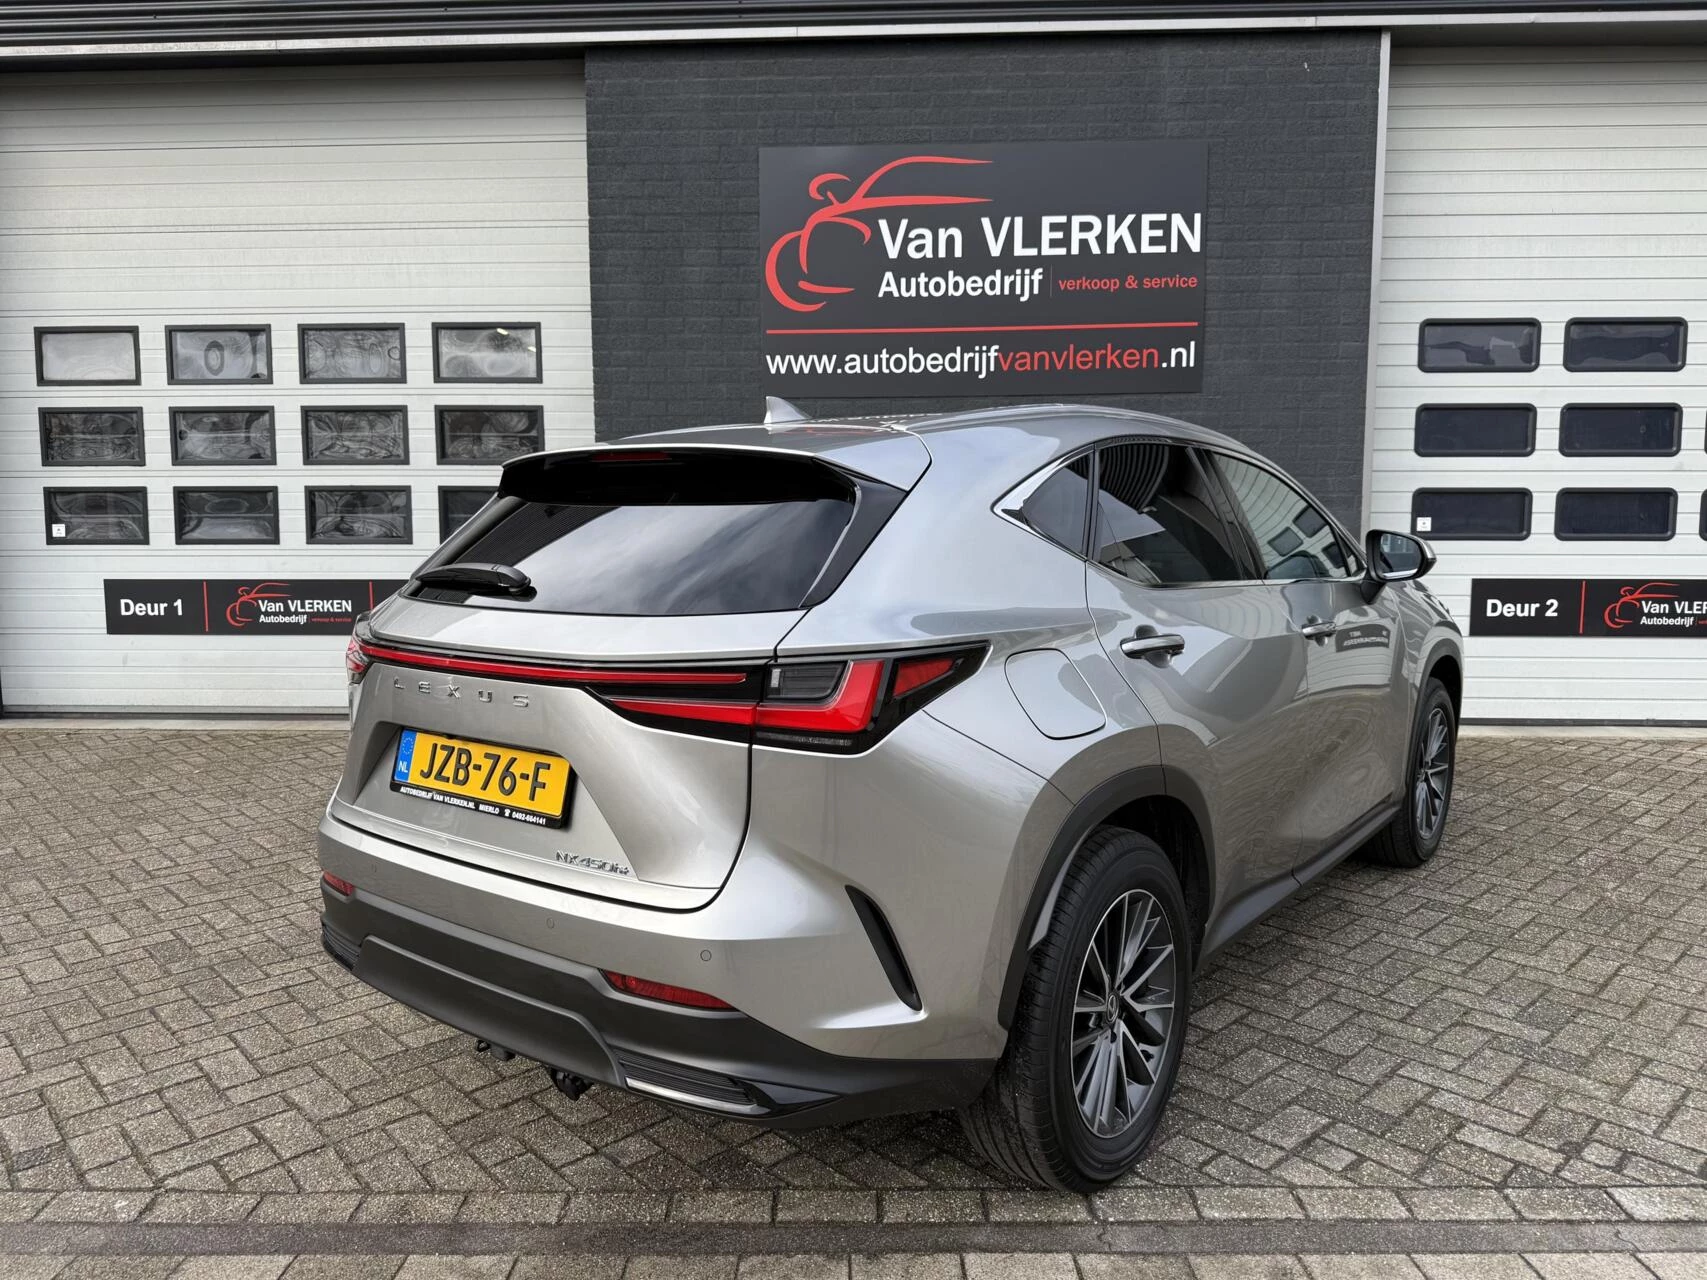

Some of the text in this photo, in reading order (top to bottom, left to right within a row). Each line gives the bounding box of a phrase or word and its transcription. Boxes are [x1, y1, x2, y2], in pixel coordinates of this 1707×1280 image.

[878, 213, 1201, 259] Van VLERKEN
[878, 268, 1043, 302] Autobedrijf
[1058, 274, 1198, 292] verkoop & service
[766, 341, 1196, 379] www.autobedrijfvanvlerken.nl
[120, 598, 183, 616] Deur 1
[258, 600, 352, 613] Van VLERKEN
[1486, 599, 1558, 617] Deur 2
[1642, 601, 1669, 614] Van
[259, 614, 307, 625] Autobedrijf
[1640, 616, 1694, 627] Autobedrijf
[393, 677, 529, 707] LEXUS
[398, 761, 408, 773] NL
[420, 743, 549, 801] JZB-76-F
[400, 786, 433, 799] AUTOBEDRIJF
[433, 793, 444, 802] VAN
